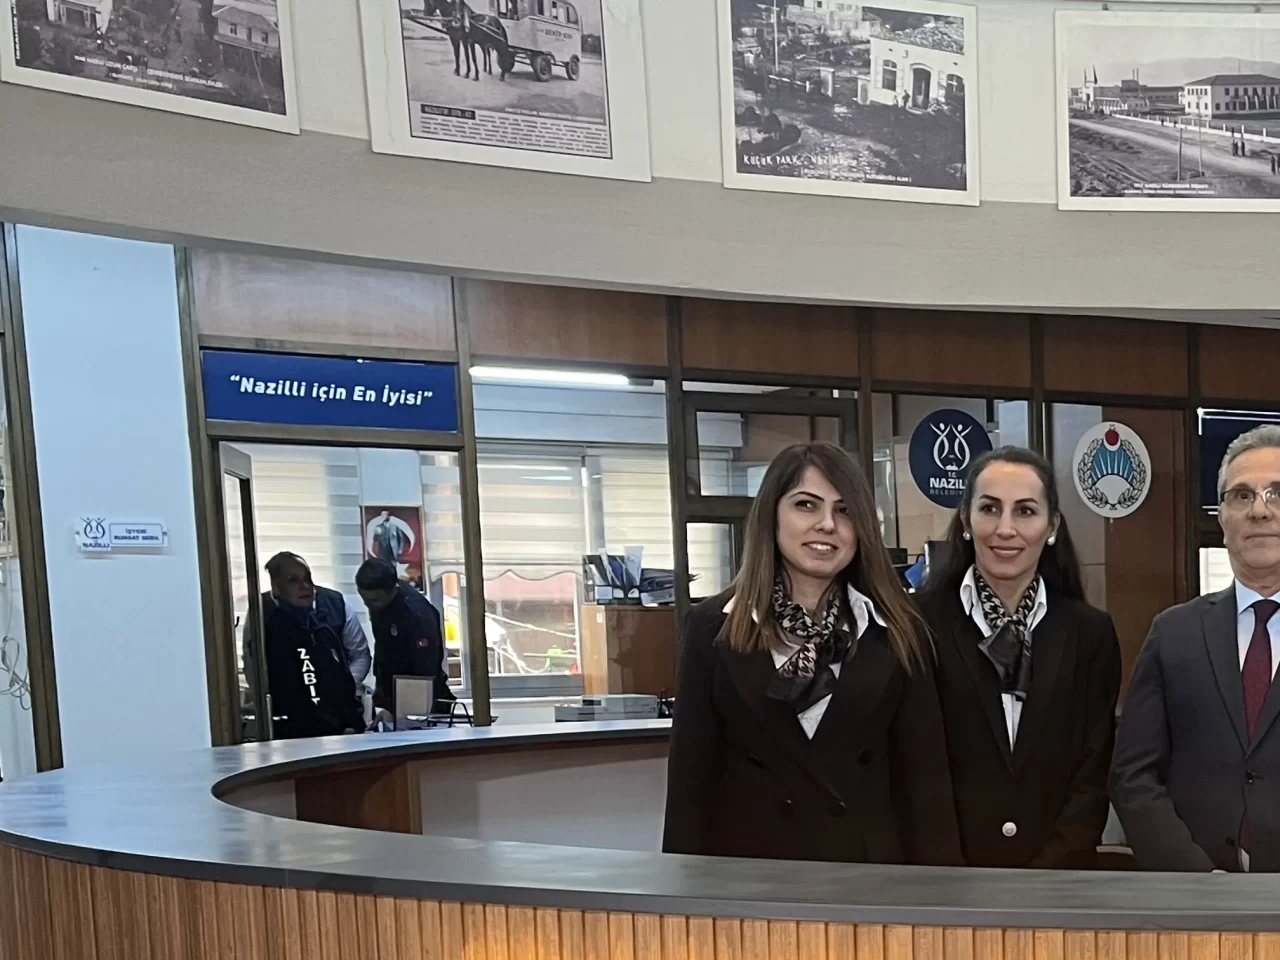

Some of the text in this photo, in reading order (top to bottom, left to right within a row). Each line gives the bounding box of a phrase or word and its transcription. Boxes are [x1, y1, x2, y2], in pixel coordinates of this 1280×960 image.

[776, 154, 799, 166] PARK
[311, 383, 347, 402] için
[352, 386, 377, 402] En
[382, 384, 433, 407] İyisi”
